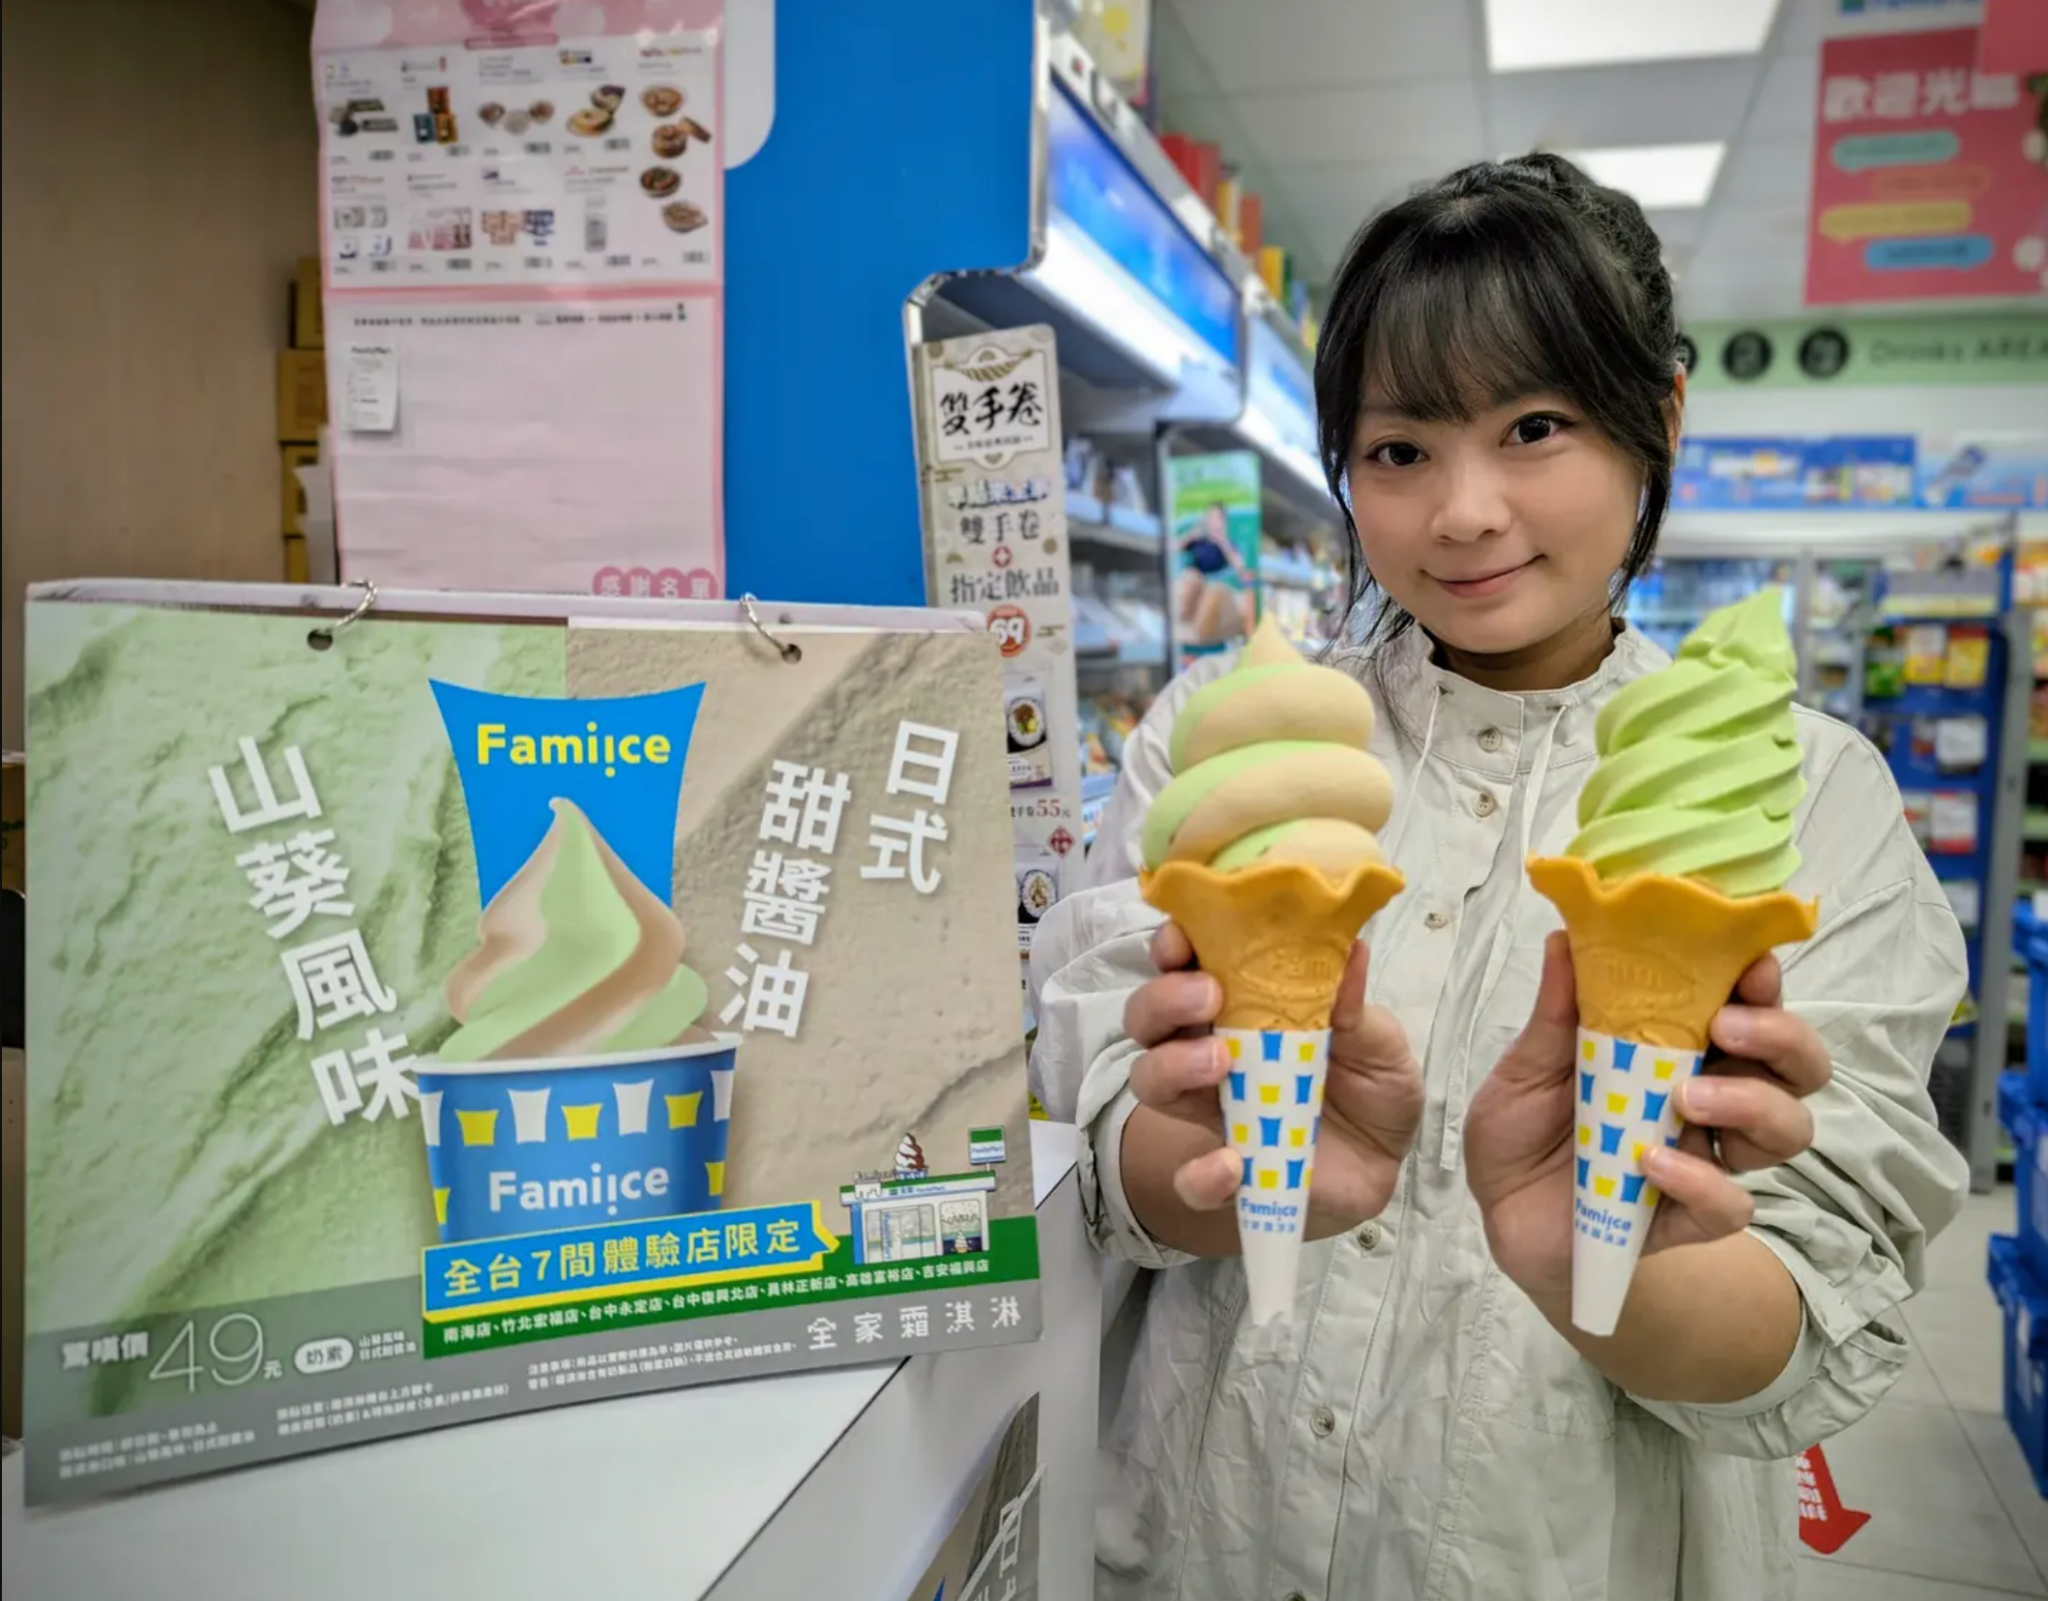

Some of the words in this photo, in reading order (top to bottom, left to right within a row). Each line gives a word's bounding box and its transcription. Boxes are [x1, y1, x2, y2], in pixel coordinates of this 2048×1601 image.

[940, 381, 1044, 437] 雙手卷
[960, 509, 1040, 546] 雙手卷
[950, 567, 1060, 605] 指定飲品
[859, 719, 959, 895] 日式
[718, 758, 852, 1038] 甜醬油
[208, 736, 419, 1126] 山葵風味
[443, 1217, 801, 1298] 全台7間體驗店限定
[807, 1295, 1022, 1351] 全家霜淇淋
[305, 1343, 345, 1366] 奶素
